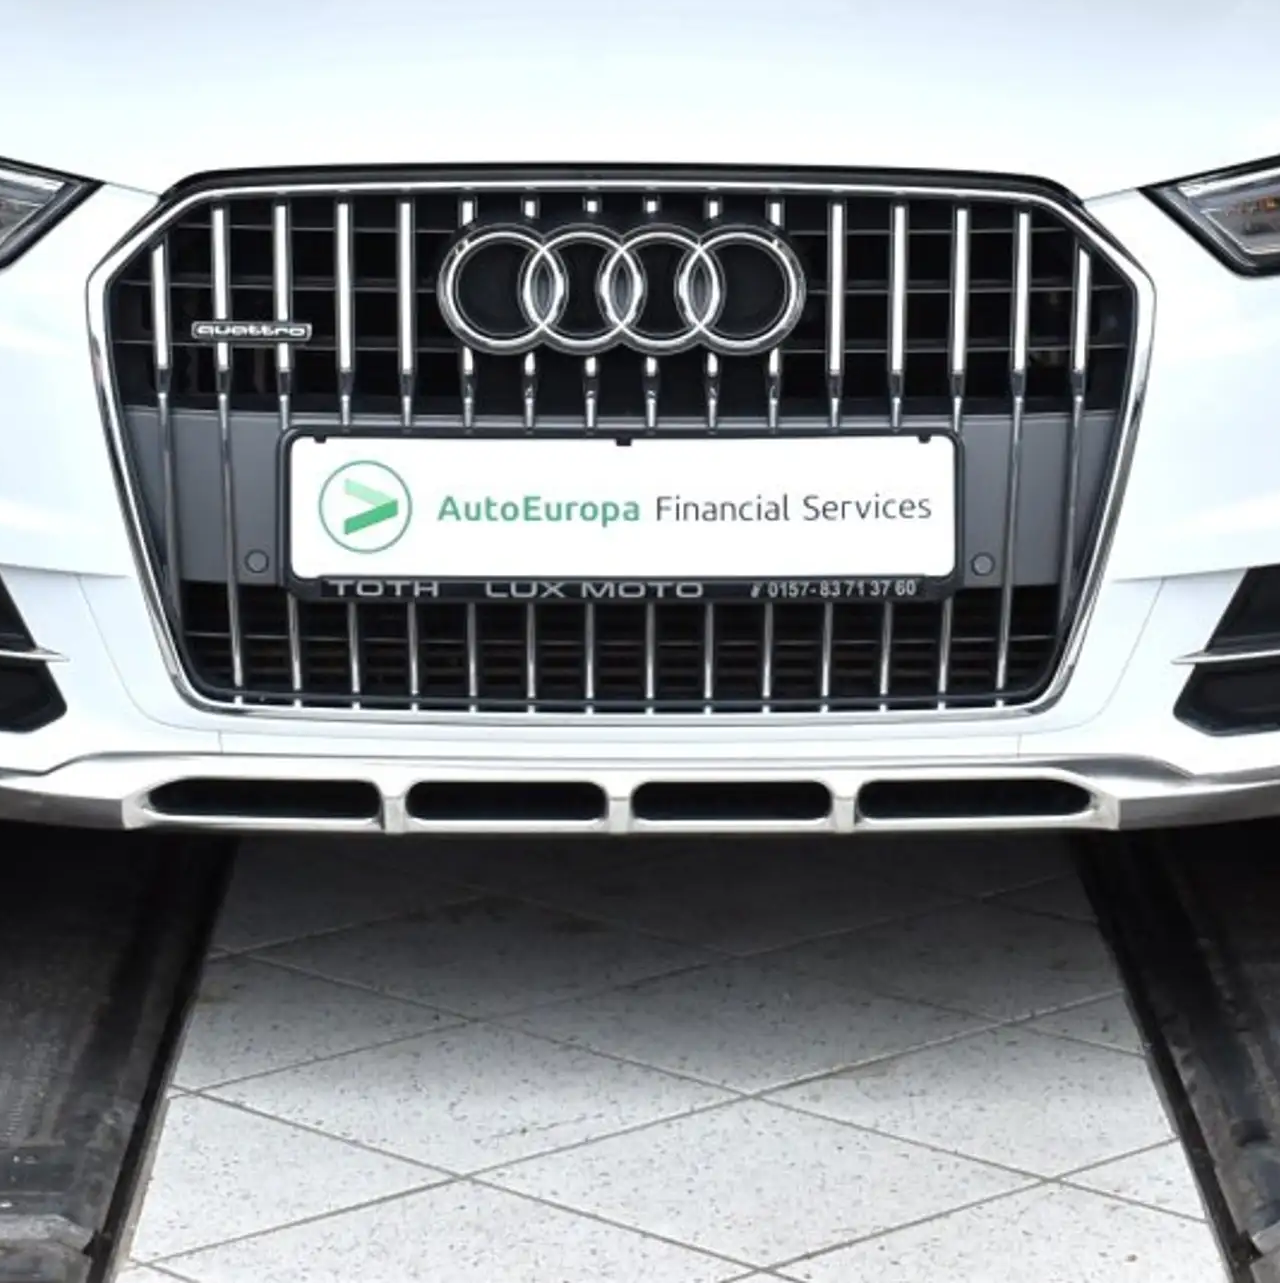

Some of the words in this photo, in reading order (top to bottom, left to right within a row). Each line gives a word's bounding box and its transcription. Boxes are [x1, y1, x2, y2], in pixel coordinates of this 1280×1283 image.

[197, 325, 306, 337] quattro
[437, 495, 640, 528] AutoEuropa
[656, 494, 790, 522] Financial
[802, 493, 932, 522] Services
[327, 579, 439, 598] TOTH
[485, 581, 566, 598] LUX
[581, 581, 704, 599] MOTO
